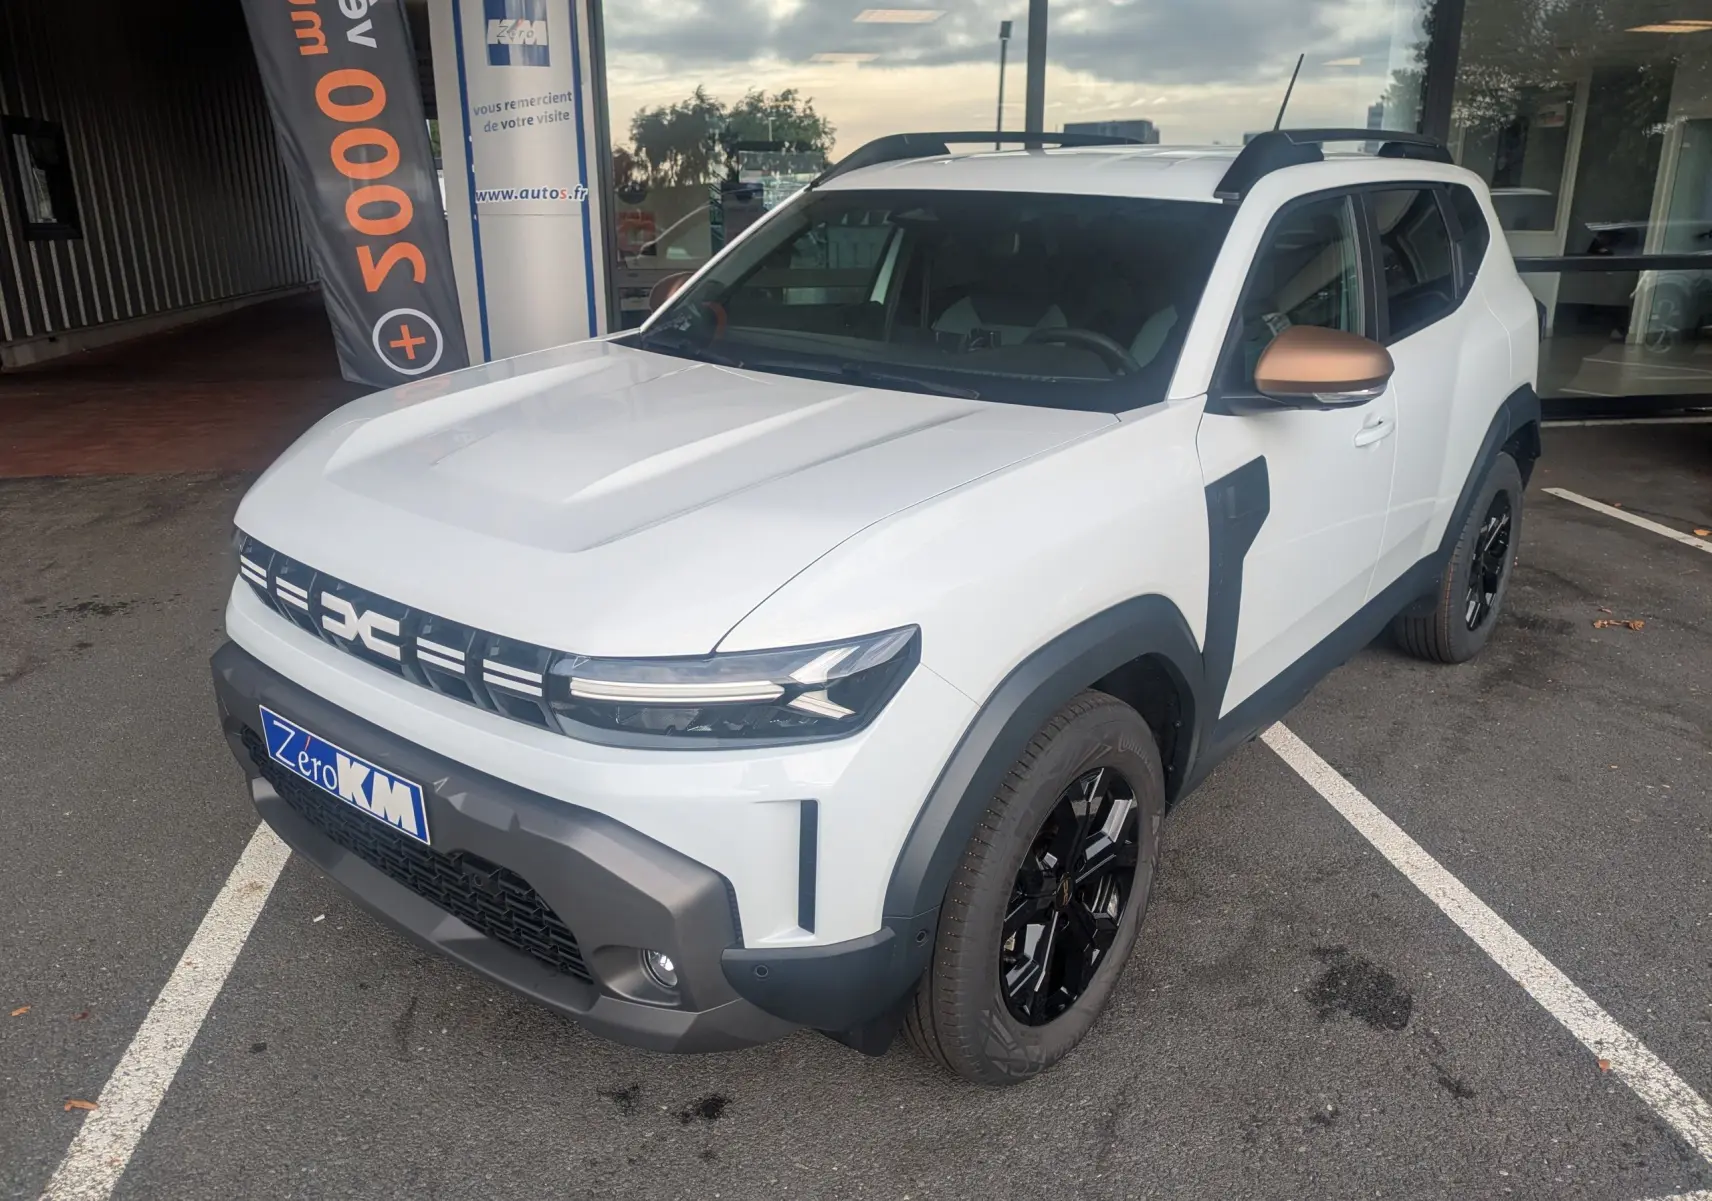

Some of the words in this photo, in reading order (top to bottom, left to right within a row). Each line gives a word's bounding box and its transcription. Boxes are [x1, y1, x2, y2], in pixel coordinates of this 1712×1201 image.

[473, 102, 502, 116] vous
[504, 91, 572, 111] remercient
[484, 120, 499, 133] de
[501, 115, 534, 130] votre
[537, 109, 570, 125] visite
[476, 185, 588, 203] www.autos.fr
